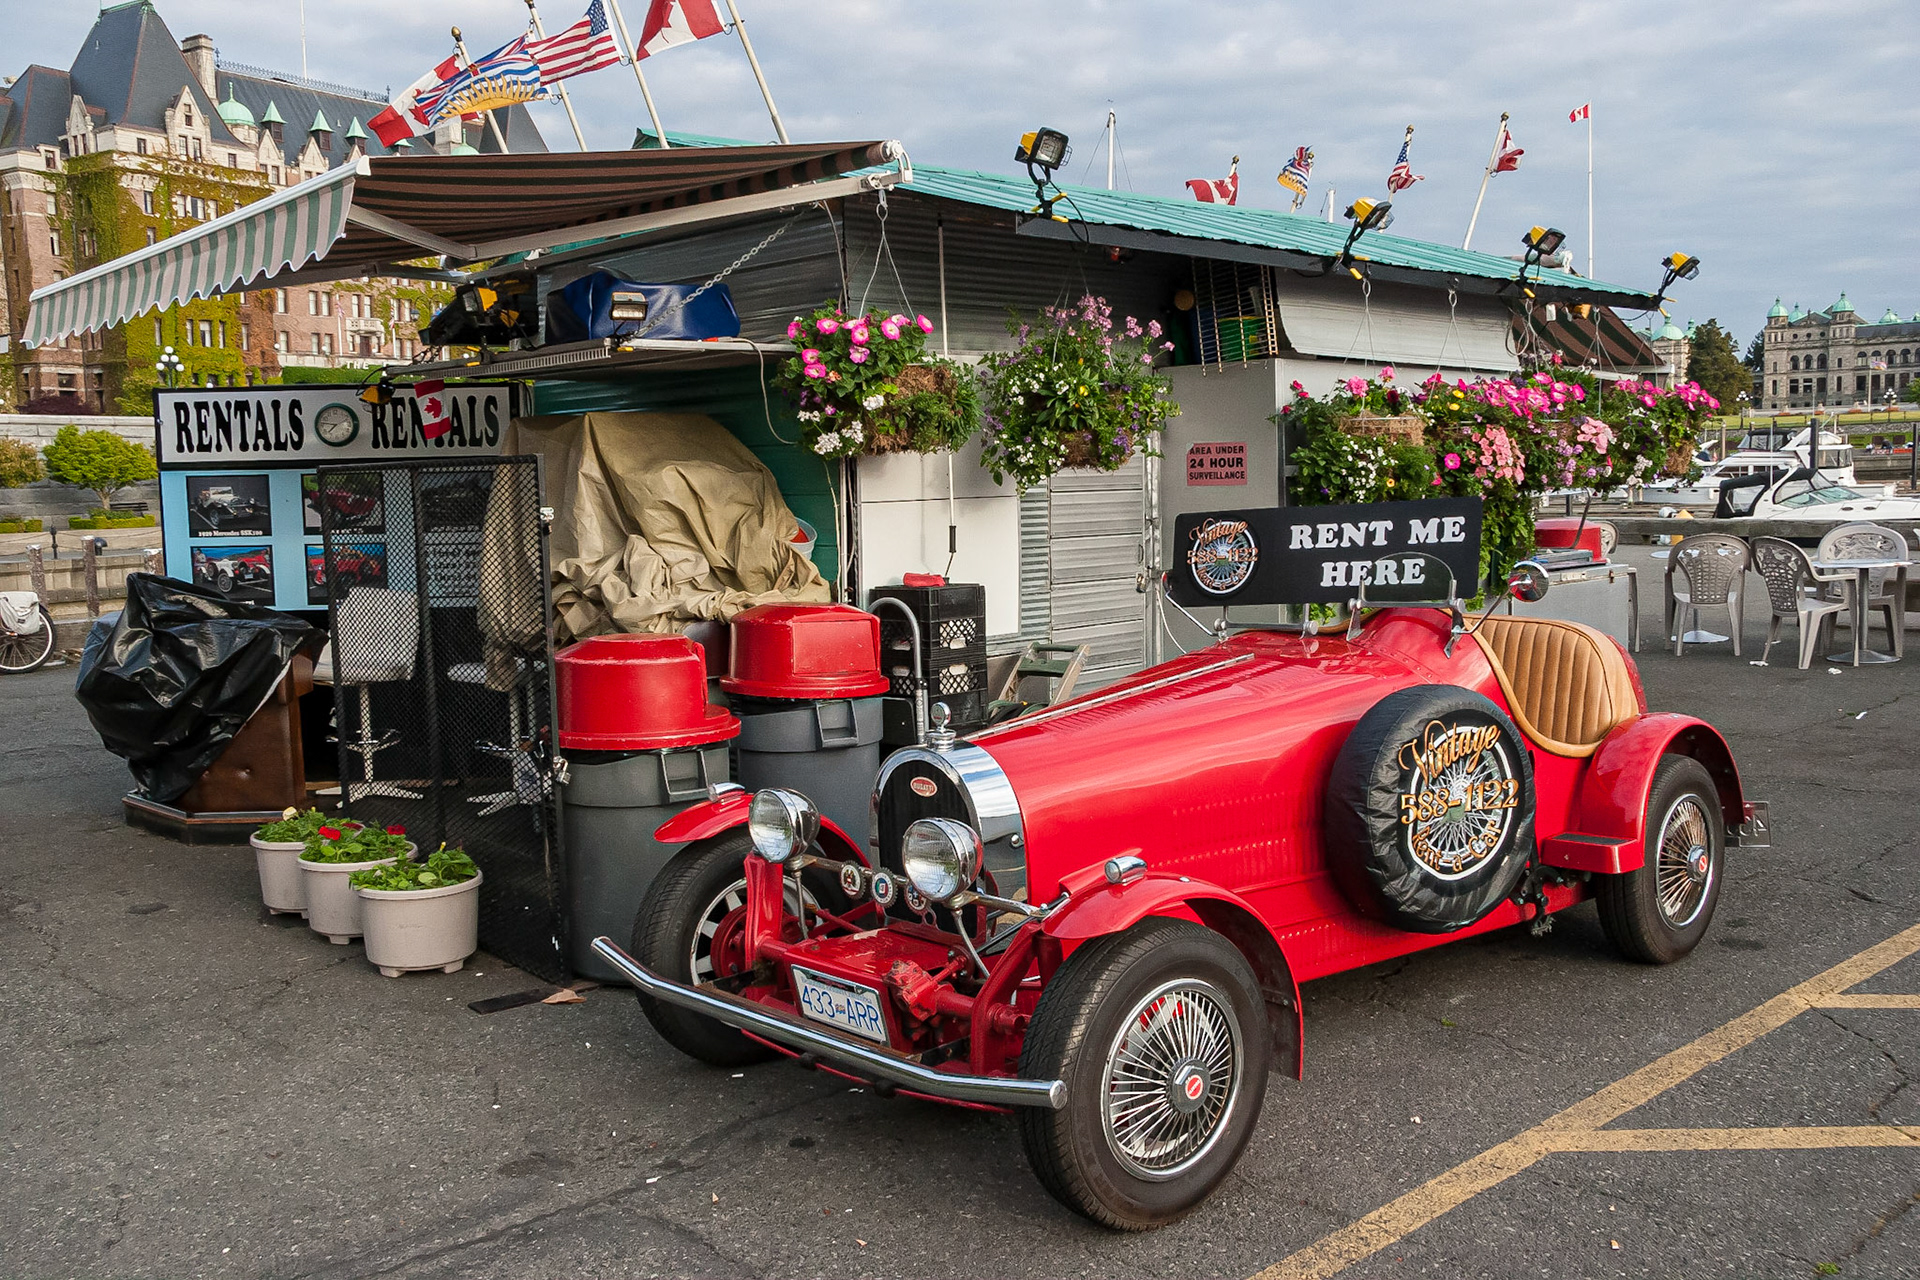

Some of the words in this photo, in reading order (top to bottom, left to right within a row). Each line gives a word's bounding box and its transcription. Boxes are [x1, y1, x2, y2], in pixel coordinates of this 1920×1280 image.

[346, 361, 369, 370] THE
[173, 399, 305, 453] RENTALS
[371, 395, 500, 449] RENALS
[1189, 446, 1212, 455] AREA
[1215, 445, 1244, 454] UNDER
[1190, 458, 1204, 469] 24
[1210, 457, 1243, 468] HOUR
[1189, 471, 1245, 480] SURVEILLANCE
[1189, 518, 1248, 547] Vintage
[1289, 520, 1394, 549] RENT
[1407, 516, 1466, 545] ME
[1187, 547, 1259, 564] 588-1122
[1320, 558, 1426, 587] HERE
[1398, 720, 1501, 788] Vintage
[1400, 778, 1520, 825] 588-1122
[1412, 820, 1502, 873] Rent-a-Car
